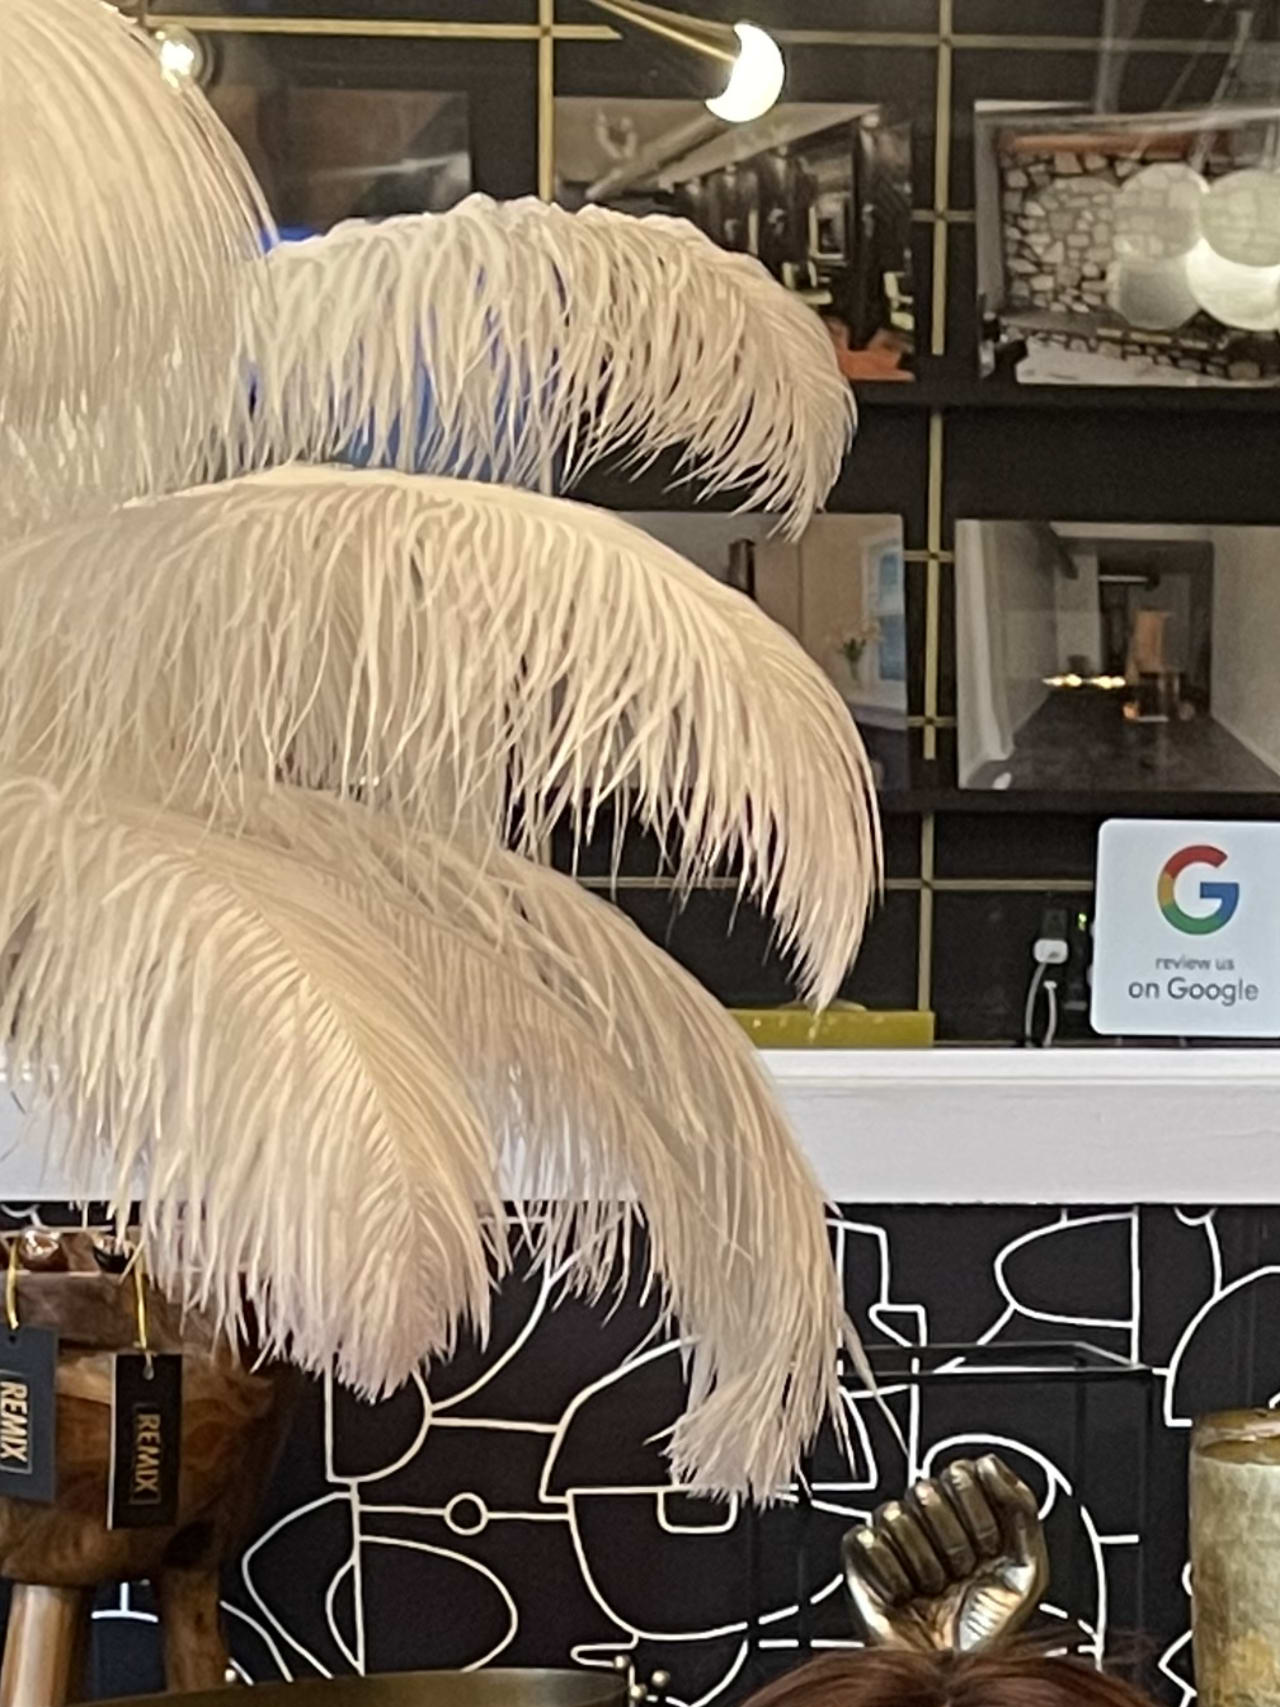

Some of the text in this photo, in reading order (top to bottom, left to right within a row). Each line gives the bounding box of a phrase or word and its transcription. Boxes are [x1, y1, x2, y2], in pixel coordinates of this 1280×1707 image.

[1155, 955, 1235, 971] review us
[1128, 976, 1259, 1007] on Google
[134, 1411, 161, 1494] REMIX
